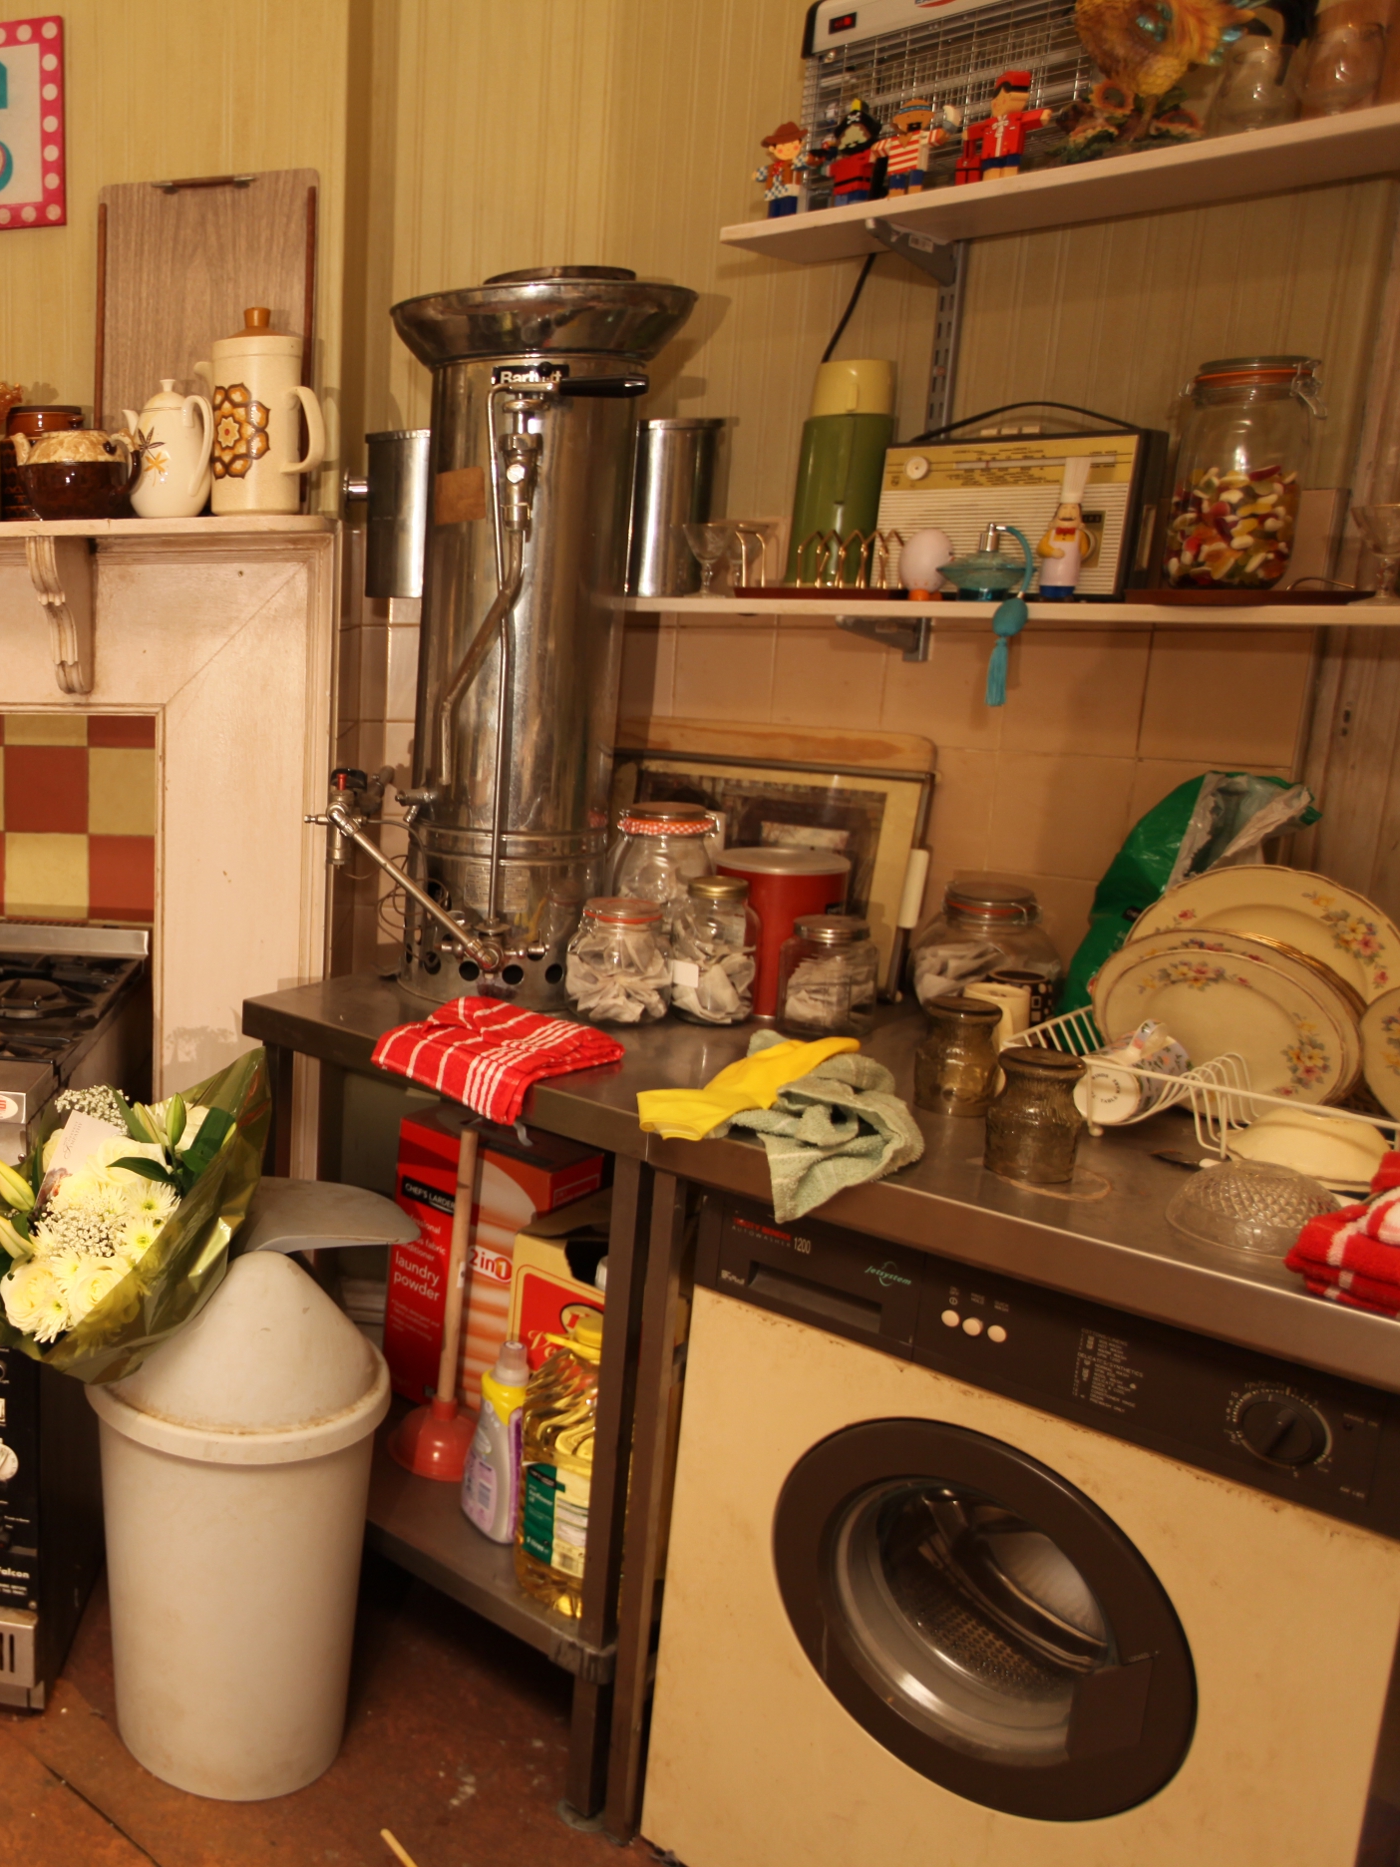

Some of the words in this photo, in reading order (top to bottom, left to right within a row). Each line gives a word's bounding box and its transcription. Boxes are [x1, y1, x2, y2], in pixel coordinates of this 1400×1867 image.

[732, 1225, 792, 1248] AUTOWASHER
[794, 1236, 812, 1254] 1200
[394, 1251, 440, 1288] laundry
[393, 1270, 441, 1301] powder
